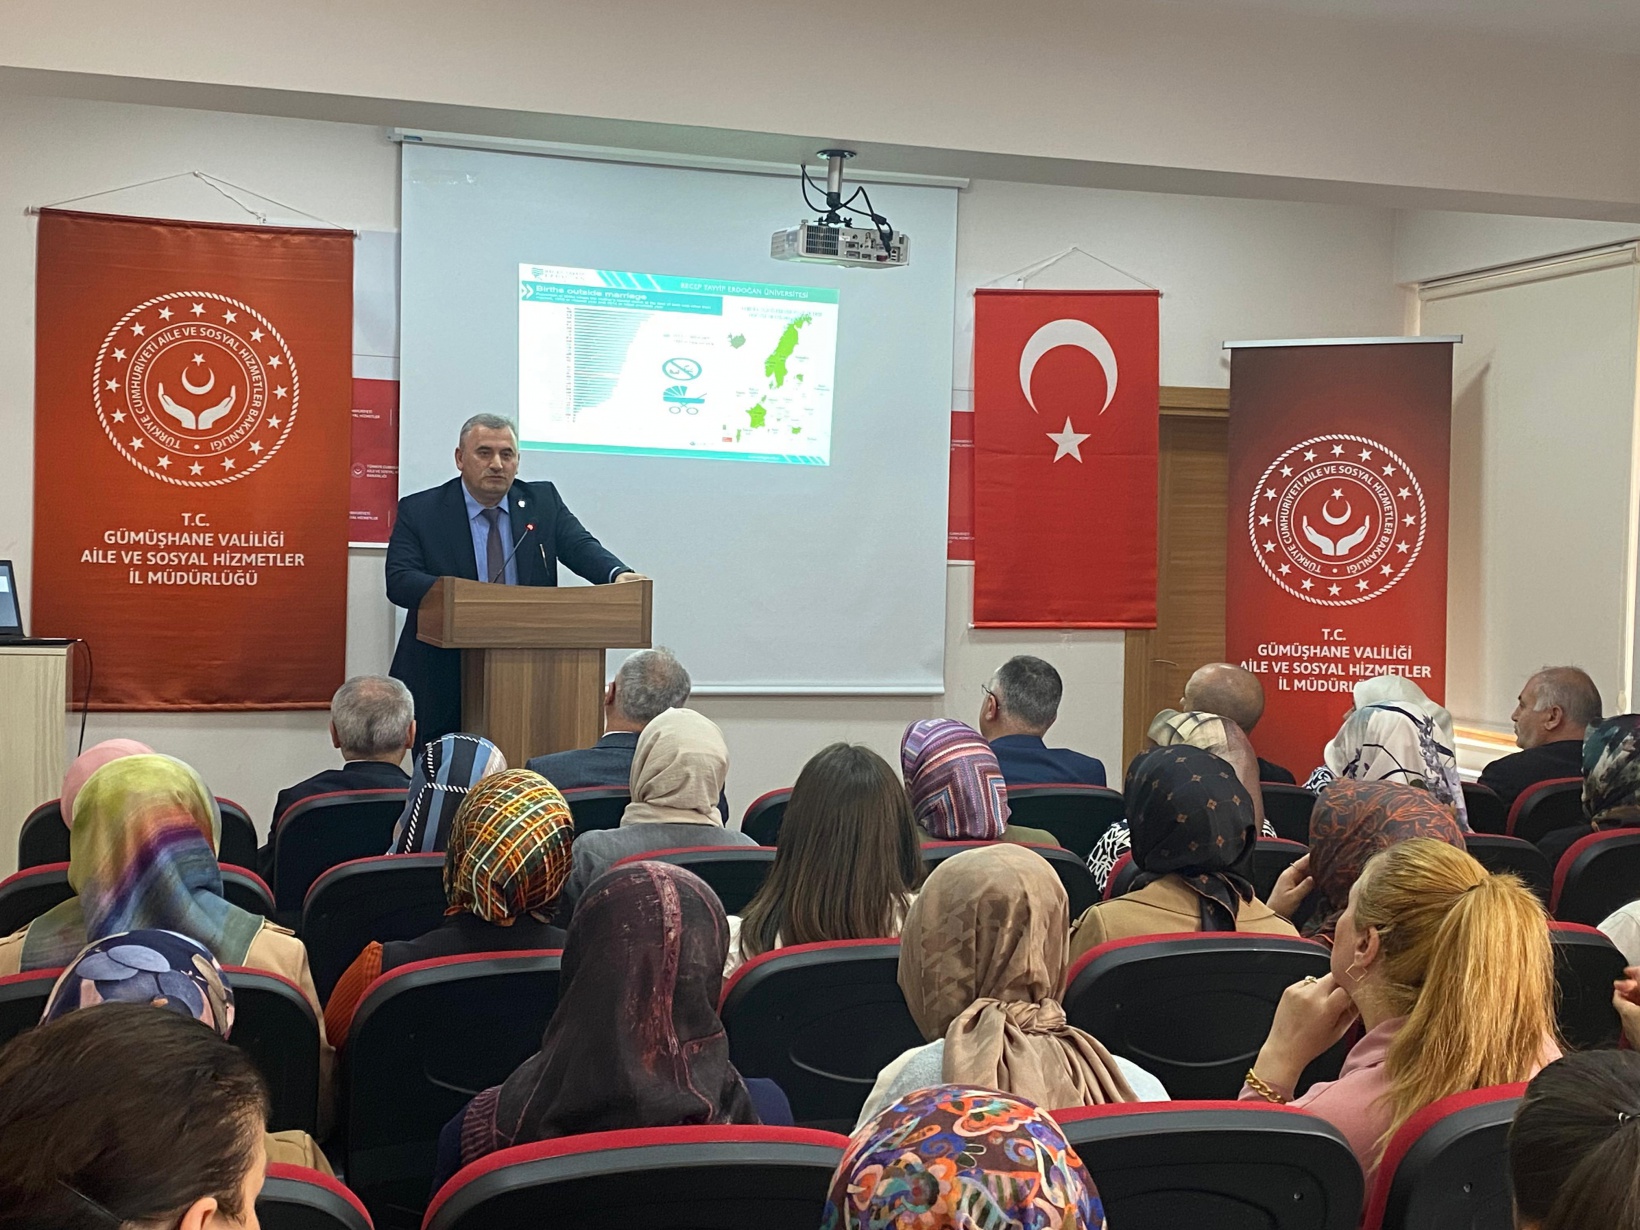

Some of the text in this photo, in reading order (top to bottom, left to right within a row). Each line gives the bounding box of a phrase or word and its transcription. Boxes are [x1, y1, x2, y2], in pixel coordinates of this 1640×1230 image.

[131, 326, 264, 451] TÜRKİYE CUMHURİYETİ AİLE VE SOSYAL HİZMETLER BAKANLIĞI
[181, 513, 210, 527] T.C.
[1280, 465, 1394, 574] TÜRKİYE CUMHURİYETİ AİLE VE SOSYAL HİZMETLER BAKANLIĞI
[104, 528, 284, 549] GÜMÜŞHANE VALİLİĞİ
[81, 547, 305, 567] AİLE VE SOSYAL HİZMETLER
[130, 568, 258, 586] İL MÜDÜRLÜĞÜ
[1322, 629, 1346, 641] T.C.
[1257, 642, 1412, 660] GÜMÜŞHANE VALİLİĞİ
[1272, 661, 1289, 674] VE
[1293, 661, 1345, 675] SOSYAL
[1349, 660, 1431, 678] HİZMETLER
[1279, 676, 1290, 690] İL
